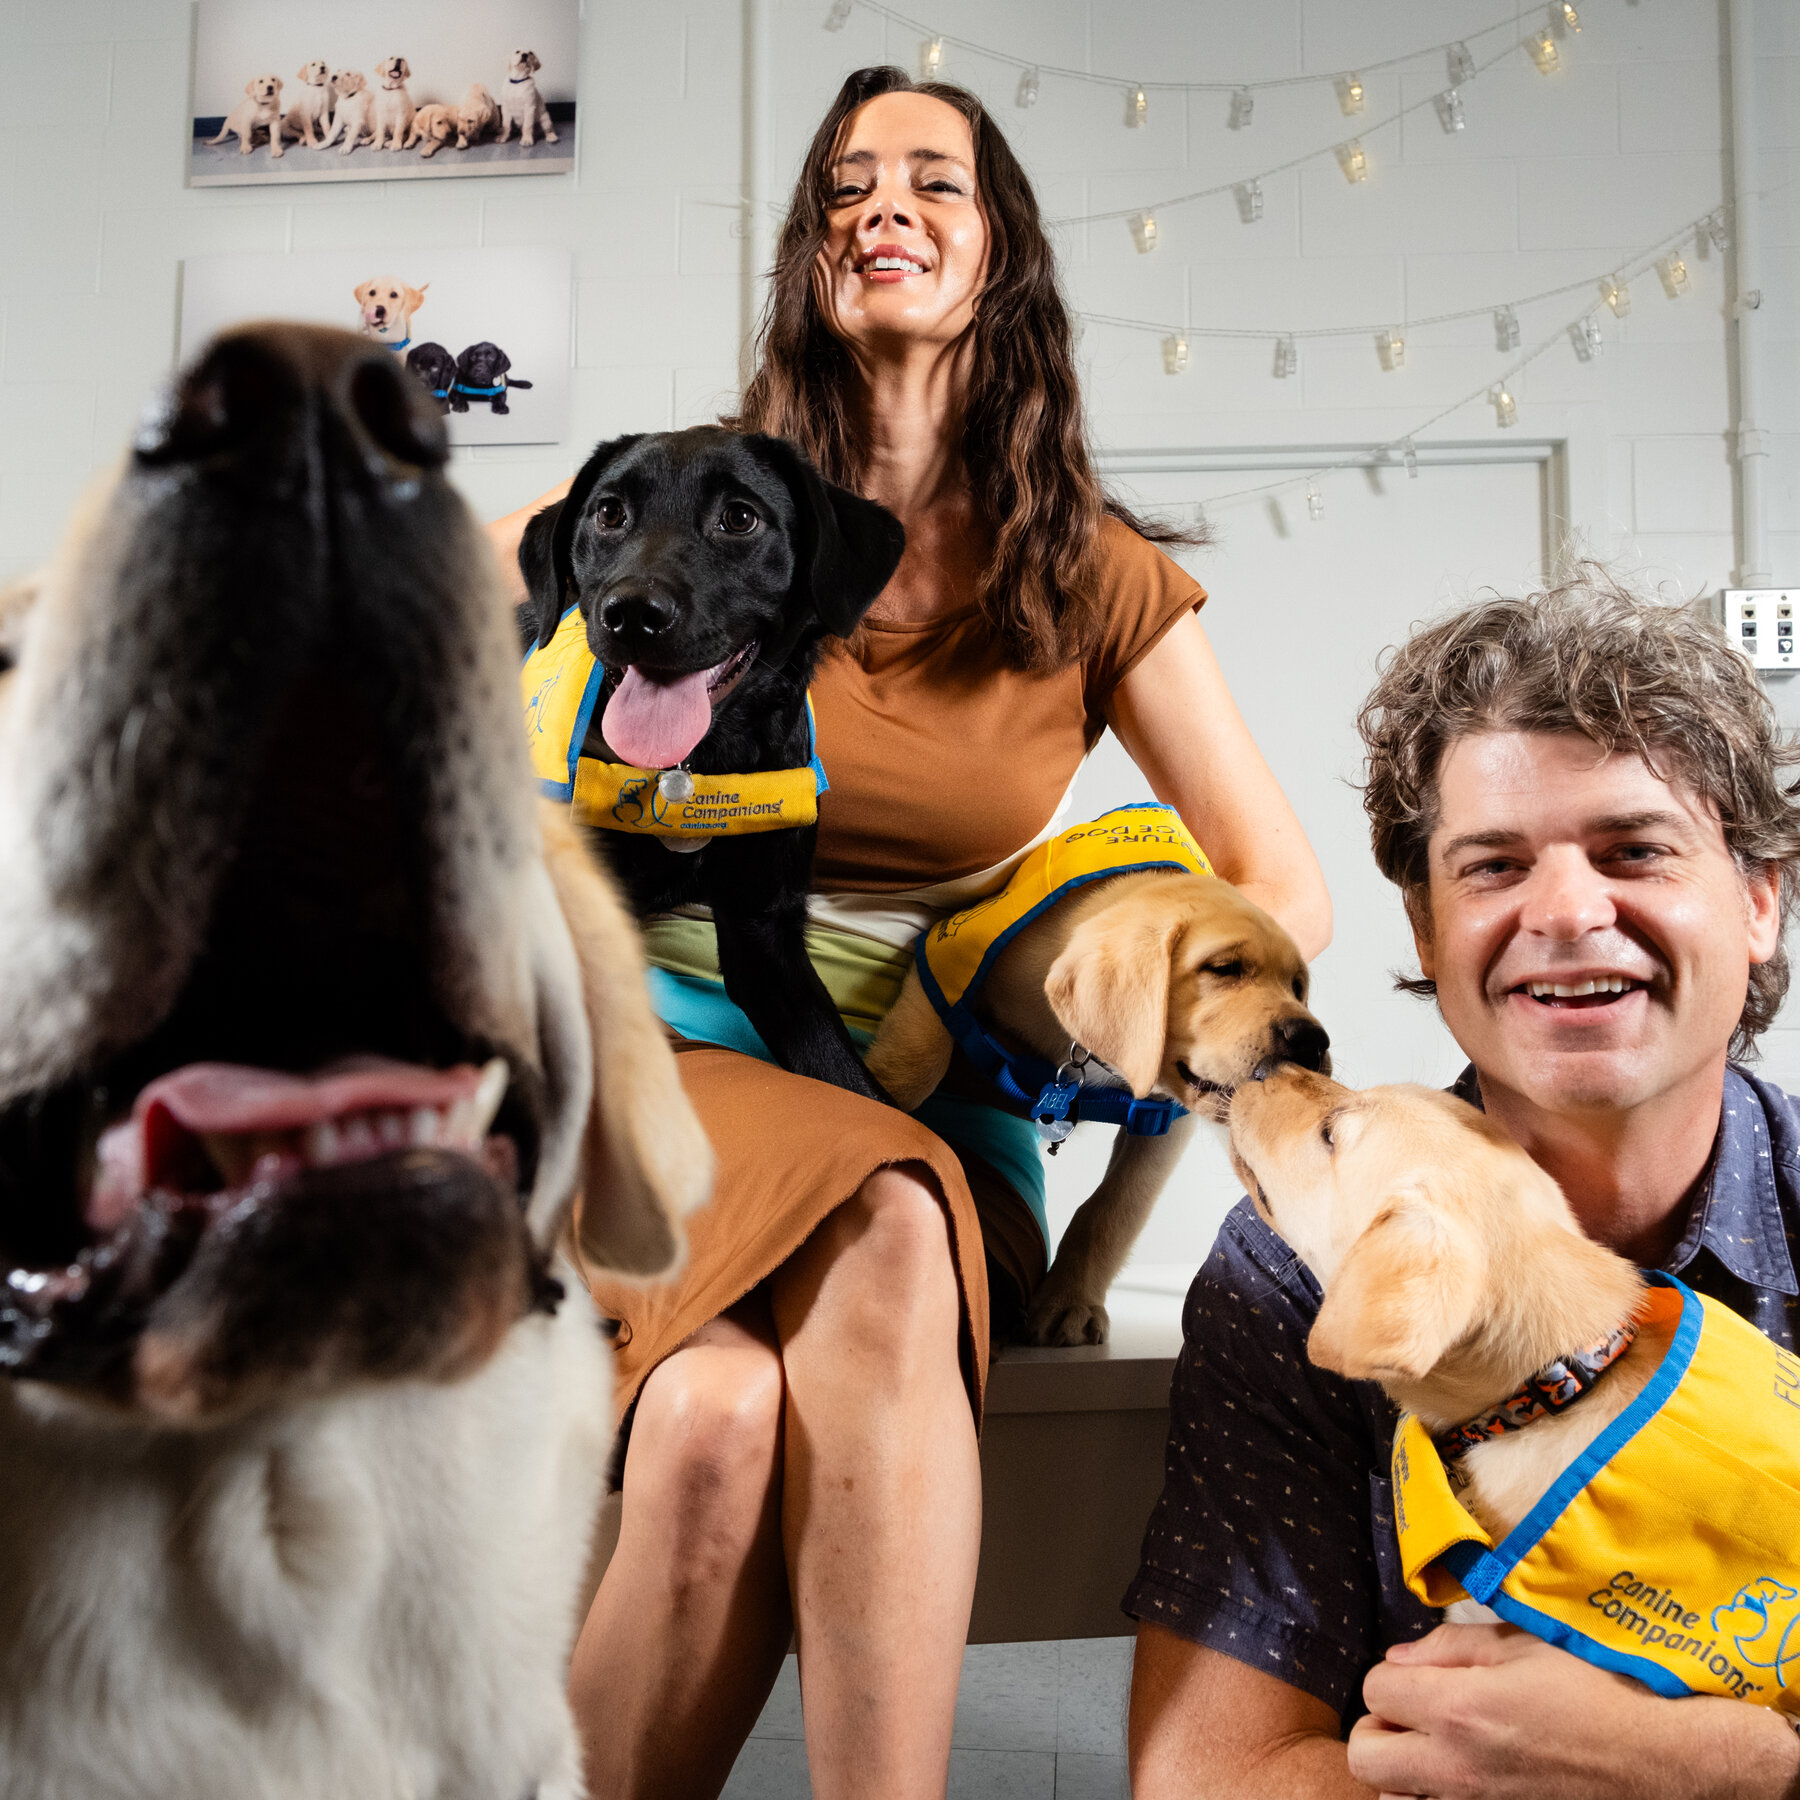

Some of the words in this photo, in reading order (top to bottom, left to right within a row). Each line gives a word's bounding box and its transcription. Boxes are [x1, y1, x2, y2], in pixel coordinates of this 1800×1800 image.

[1065, 826, 1129, 843] DOG
[1037, 1093, 1069, 1110] ABEL
[1609, 1571, 1700, 1629] Canine
